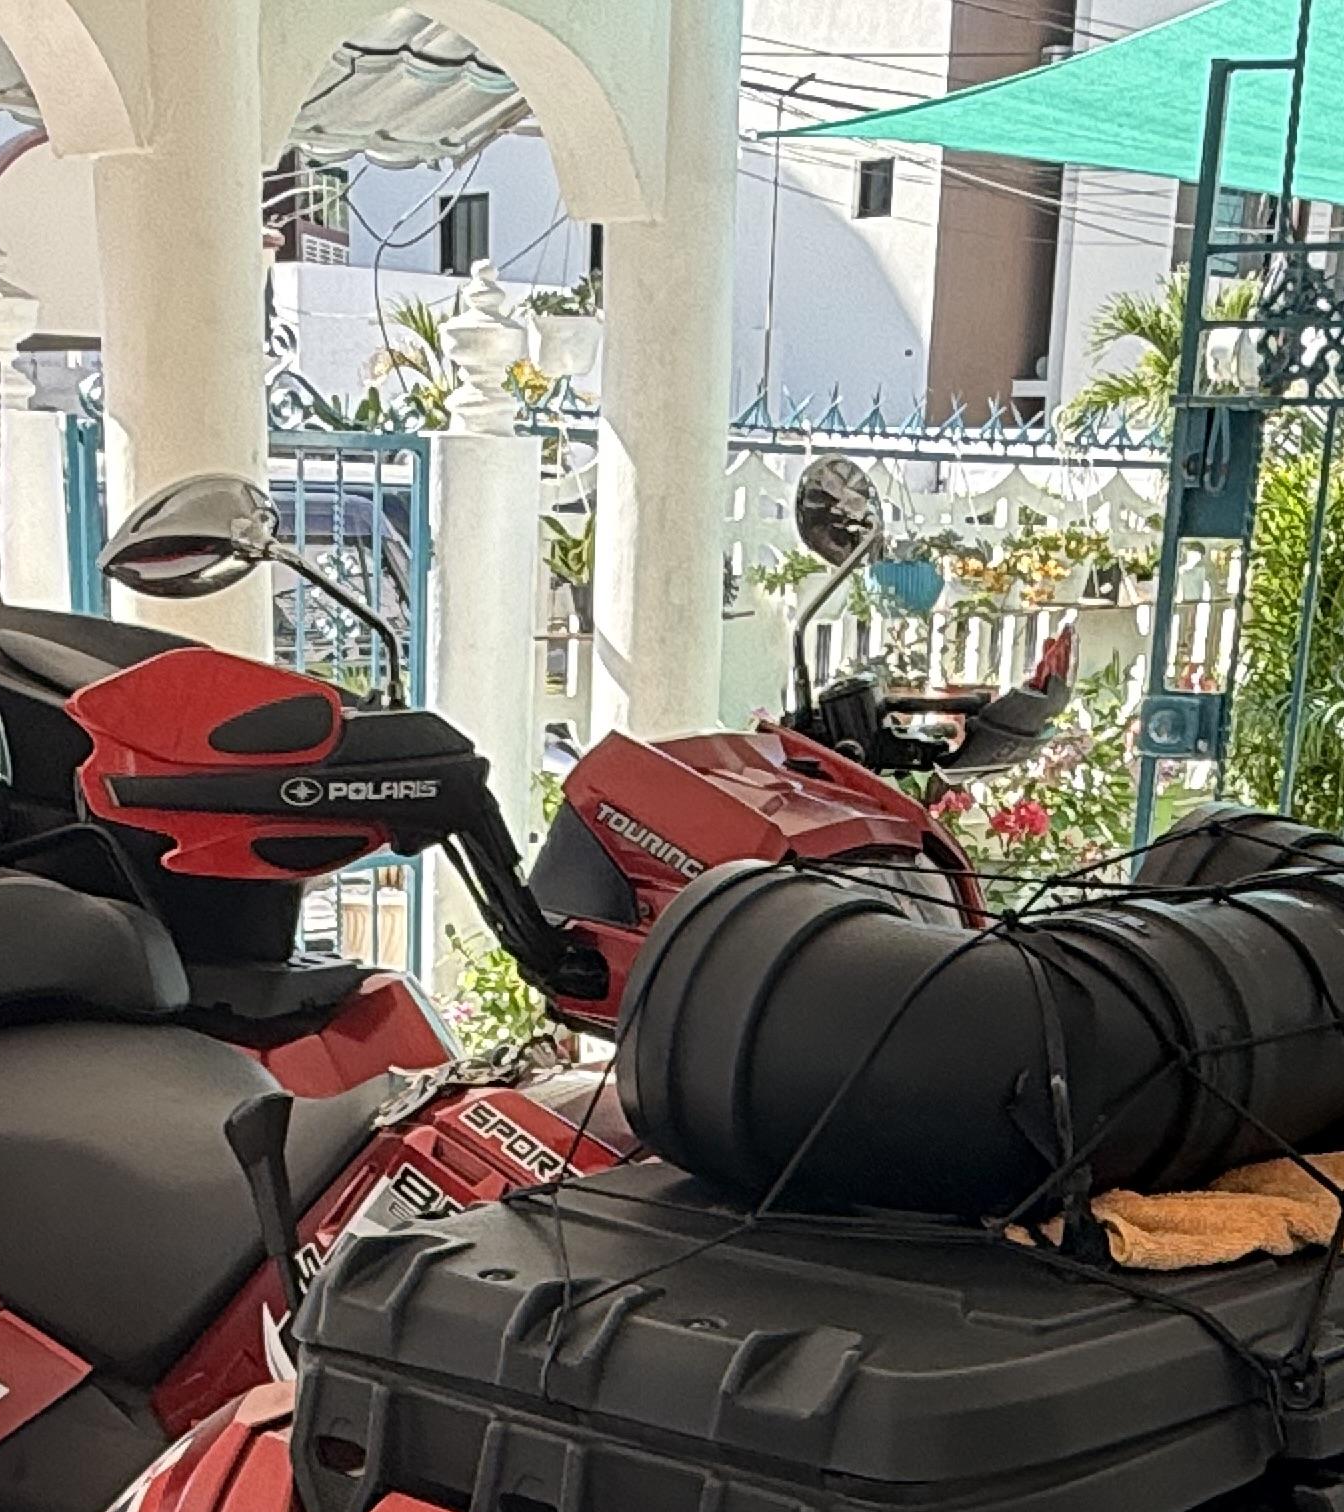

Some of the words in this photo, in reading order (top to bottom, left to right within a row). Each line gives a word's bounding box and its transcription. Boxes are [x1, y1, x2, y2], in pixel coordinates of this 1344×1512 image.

[328, 780, 442, 801] POLARIS
[596, 801, 705, 879] TOURING
[458, 1099, 585, 1185] SPOR
